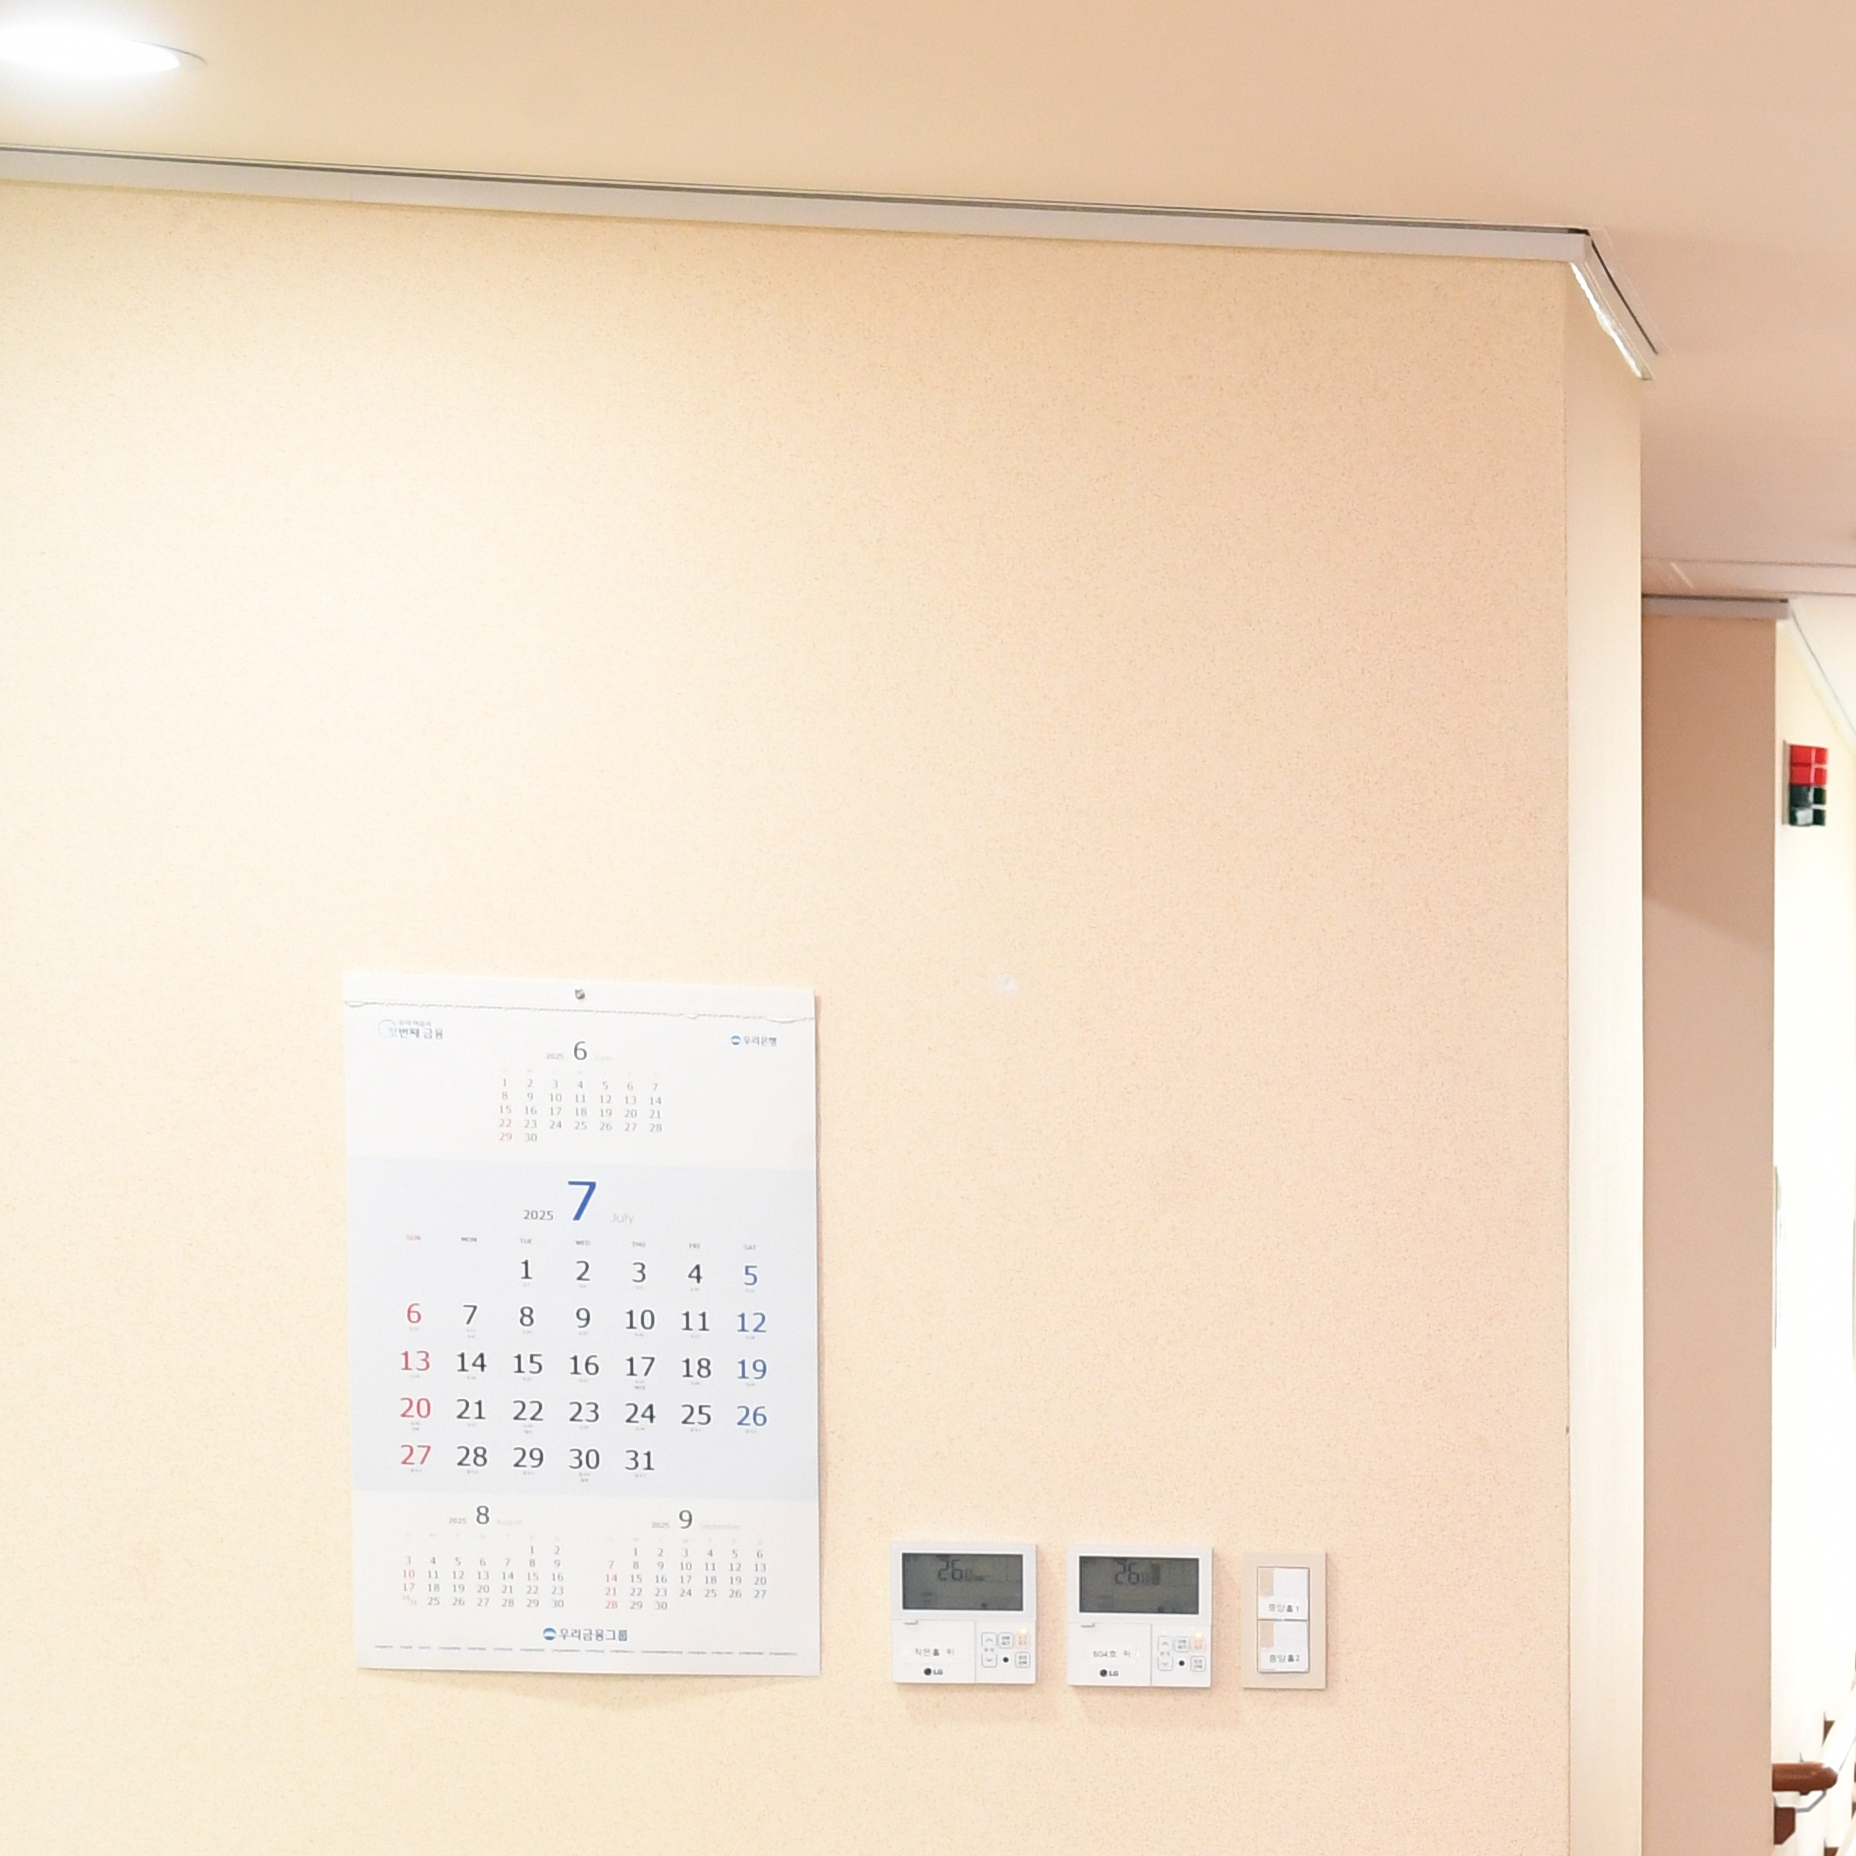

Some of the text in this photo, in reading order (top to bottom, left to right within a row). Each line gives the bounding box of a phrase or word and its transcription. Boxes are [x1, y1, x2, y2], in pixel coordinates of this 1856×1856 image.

[573, 1040, 588, 1061] 6
[549, 1092, 563, 1103] 10
[575, 1093, 586, 1104] 11
[600, 1094, 612, 1104] 12
[625, 1095, 637, 1105] 13
[650, 1096, 662, 1106] 14
[499, 1104, 661, 1120] 15 16 17 18 19 20 21
[498, 1118, 663, 1133] 22 23 24 25 26 27 28
[499, 1131, 538, 1143] 29 30
[523, 1180, 634, 1225] 2025 7 July
[521, 1259, 758, 1286] 1 2 3 4 5
[406, 1302, 767, 1333] 6 7 8 9 10 11 12
[401, 1350, 767, 1380] 13 14 15 16 17 18 19
[400, 1397, 768, 1427] 20 21 22 23 24 25 26
[400, 1444, 655, 1471] 27 28 29 30 31
[476, 1504, 490, 1525] 8
[678, 1509, 693, 1530] 9
[680, 1561, 693, 1571] 10
[704, 1562, 716, 1572] 11
[729, 1562, 742, 1572] 12
[754, 1562, 767, 1573] 13
[403, 1569, 565, 1582] 10 11 12 13 14 15 16
[605, 1573, 768, 1586] 14 15 16 17 18 19 20
[403, 1582, 565, 1596] 17 18 19 20 21 22 23
[604, 1586, 767, 1599] 21 22 23 24 25 26 27
[427, 1596, 441, 1606] 25
[451, 1596, 466, 1607] 26
[476, 1597, 490, 1607] 27
[501, 1597, 515, 1608] 28
[526, 1598, 540, 1608] 29
[552, 1598, 565, 1609] 30
[604, 1600, 668, 1611] 28 29 30
